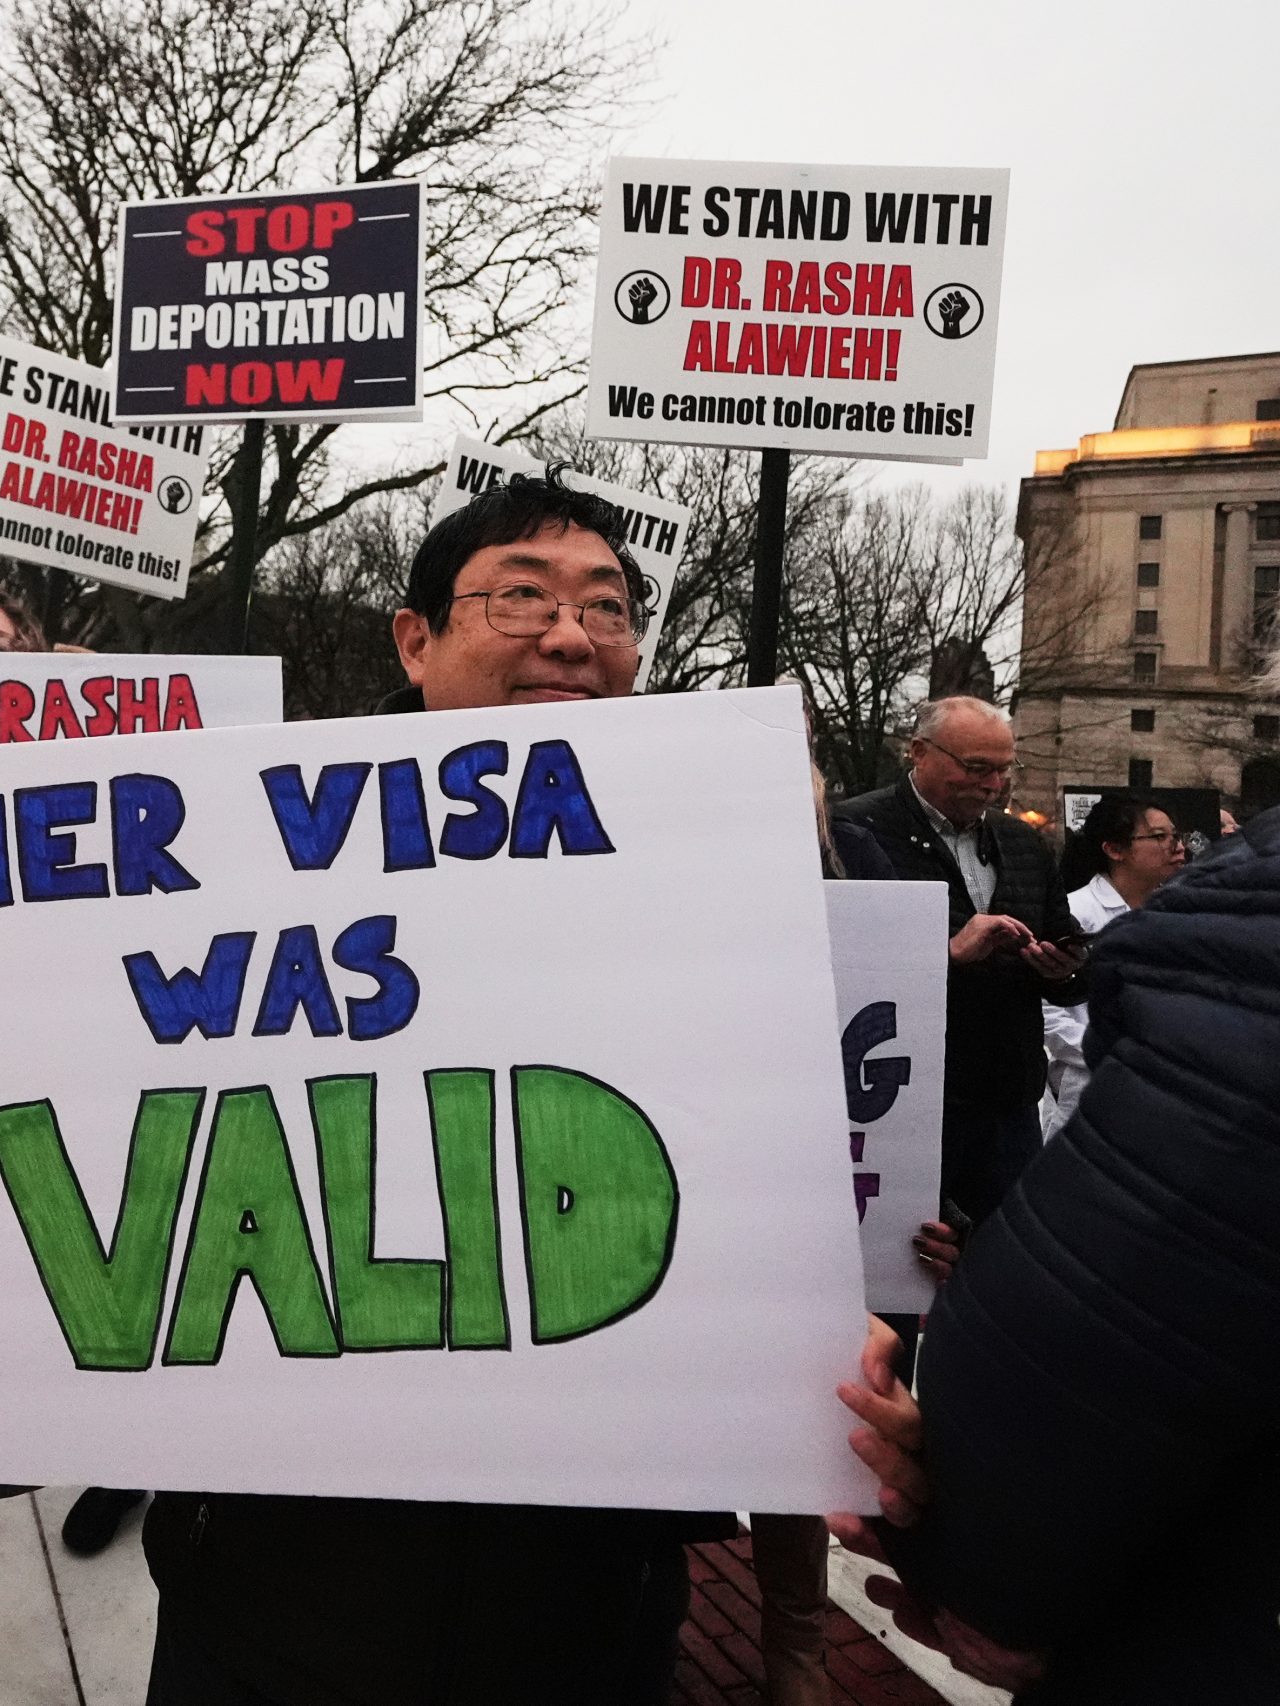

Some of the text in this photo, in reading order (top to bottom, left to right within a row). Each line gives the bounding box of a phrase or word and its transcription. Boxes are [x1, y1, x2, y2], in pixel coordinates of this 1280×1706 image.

[185, 202, 354, 257] STOP
[622, 182, 993, 246] WE STAND WITH
[205, 255, 330, 296] MASS
[680, 255, 915, 318] DR. RASHA
[130, 291, 405, 351] DEPORTATION
[682, 320, 902, 382] ALAWIEH!
[185, 358, 345, 406] NOW
[608, 385, 975, 437] We cannot tolorate this!
[1, 412, 154, 493] DR. RASHA
[55, 530, 133, 570] tolorate
[137, 551, 181, 582] this!
[259, 738, 616, 873] VISA
[122, 914, 420, 1045] WAS
